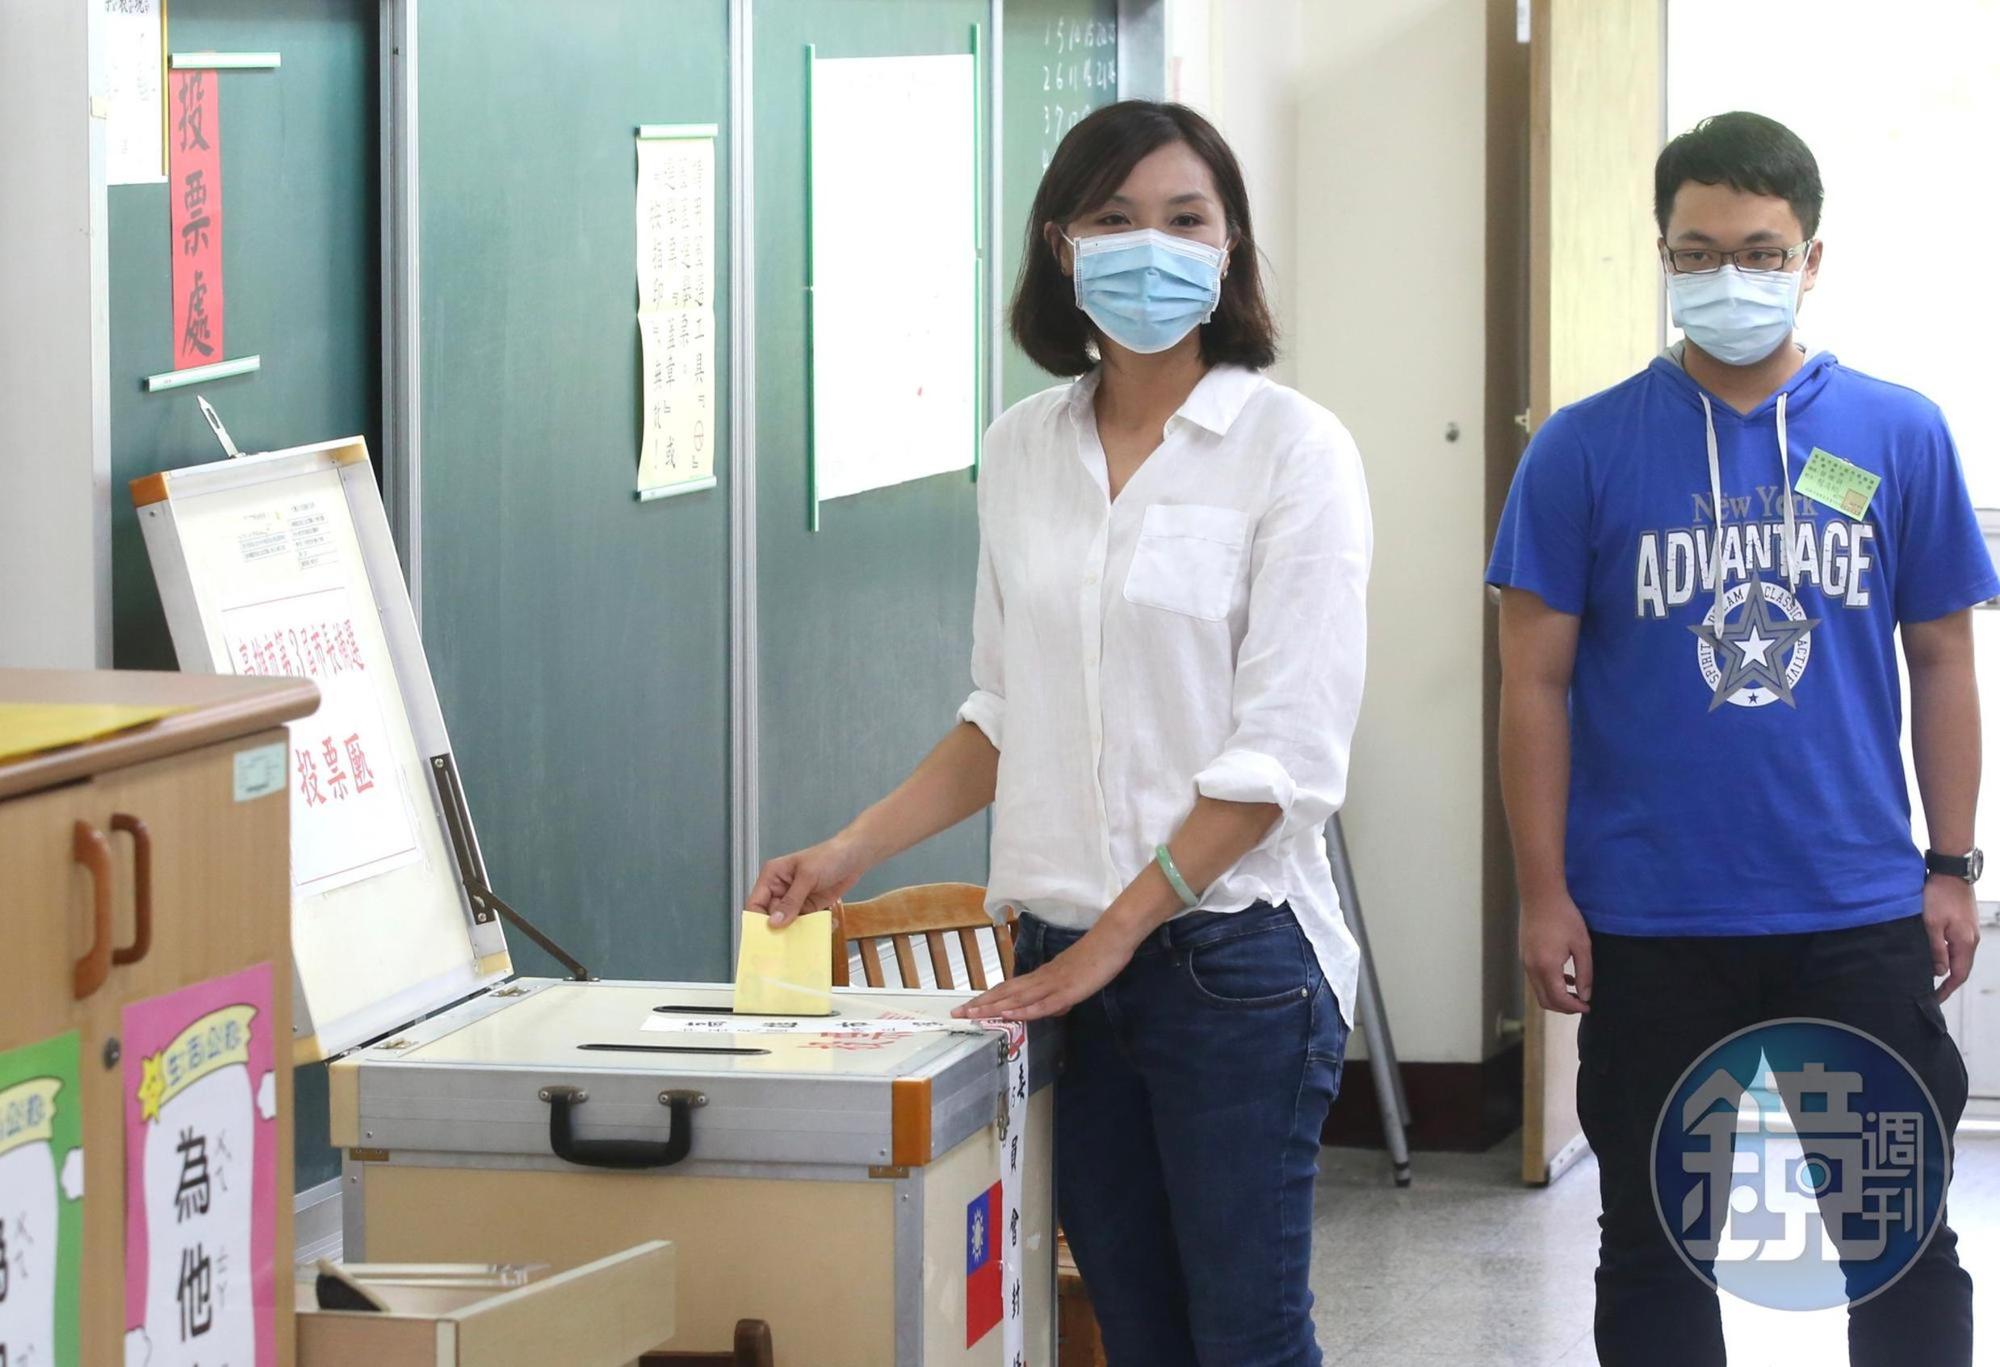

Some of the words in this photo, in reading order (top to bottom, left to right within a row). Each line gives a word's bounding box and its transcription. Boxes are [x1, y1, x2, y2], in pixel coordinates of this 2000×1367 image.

[178, 72, 214, 358] 投票處
[1691, 489, 1752, 522] New
[1636, 520, 1875, 618] ADVANTAGE
[1708, 588, 1744, 624] DAM
[1764, 585, 1803, 621] CLASSIC
[1700, 643, 1720, 684] SPIRIT
[1786, 640, 1807, 685] ACTIVE
[174, 1126, 214, 1367] 為他
